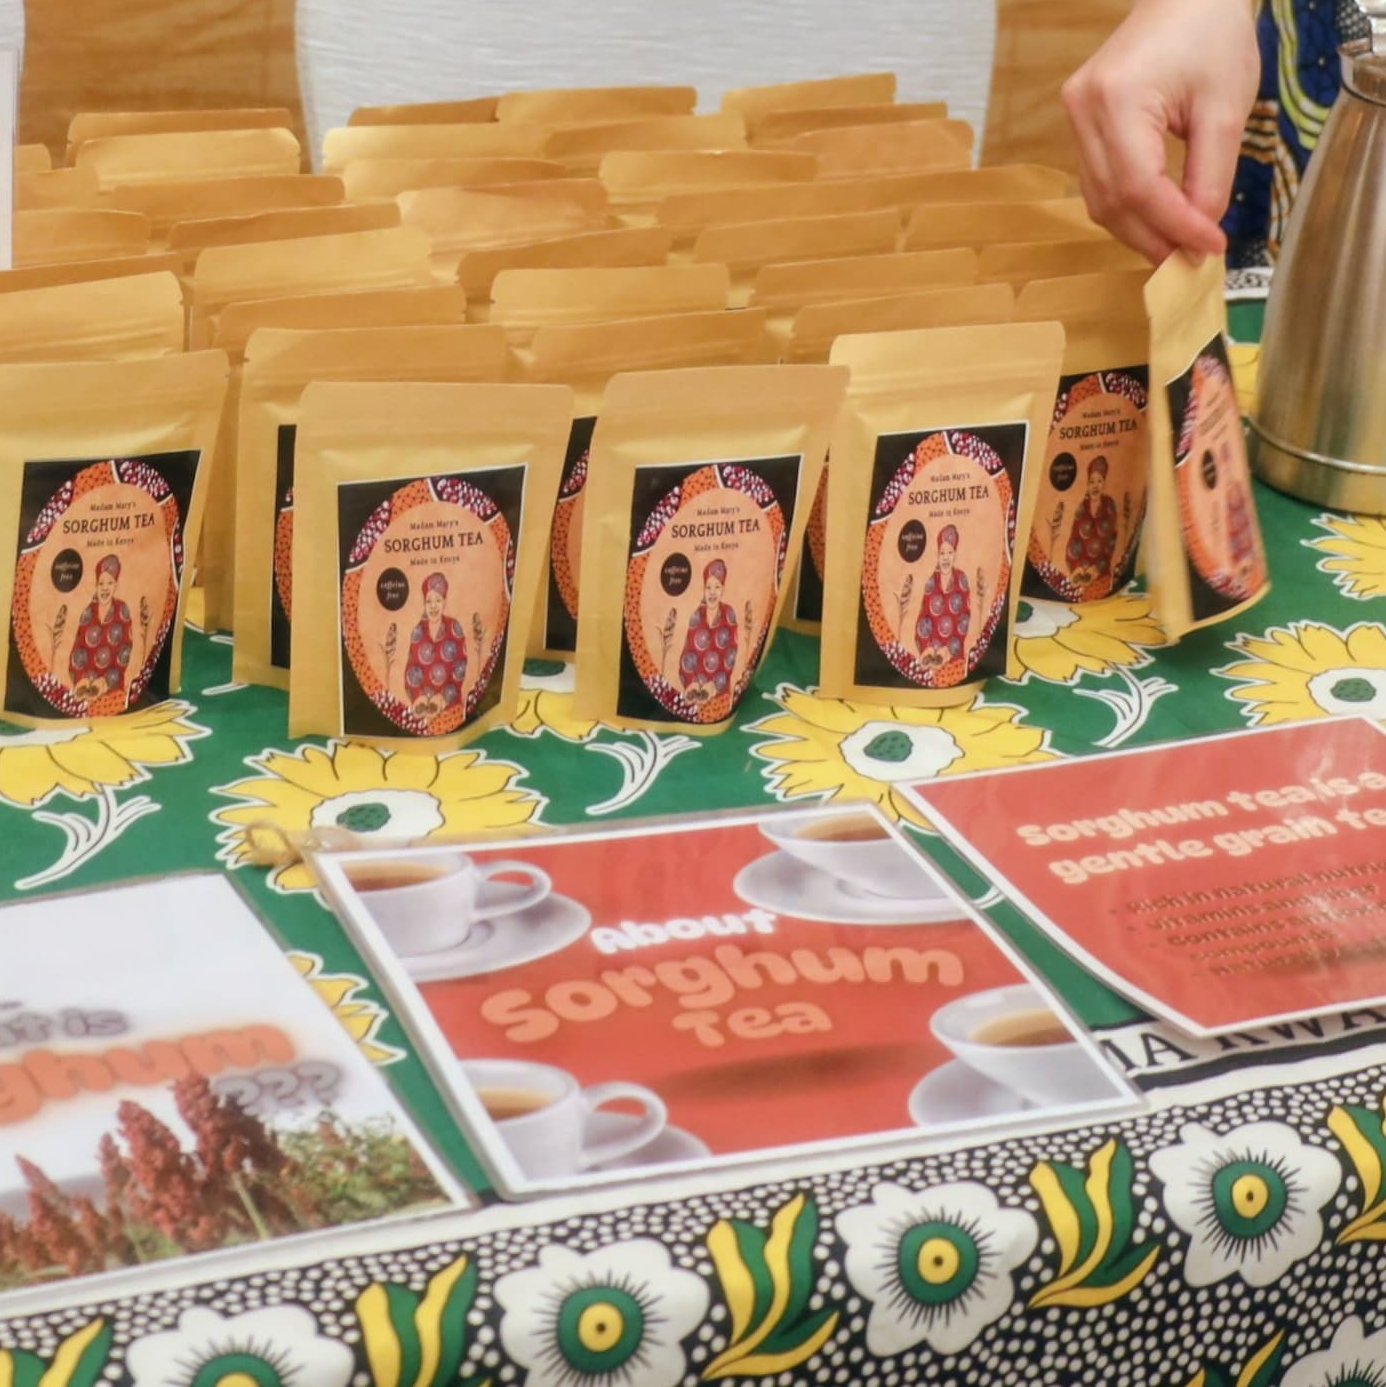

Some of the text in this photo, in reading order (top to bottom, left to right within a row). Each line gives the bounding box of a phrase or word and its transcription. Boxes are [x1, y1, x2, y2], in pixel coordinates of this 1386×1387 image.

[1059, 418, 1137, 439] SORGHUM TEA
[908, 485, 989, 505] SORGHUM TEA
[62, 513, 155, 534] SORGHUM TEA
[671, 518, 760, 539] SORGHUM TEA
[384, 531, 484, 553] SORGHUM TEA
[1015, 799, 1231, 847] Sorghum
[1225, 781, 1319, 813] tea
[1311, 776, 1359, 801] is
[1048, 836, 1215, 885] gentle
[1211, 812, 1339, 857] grain
[590, 906, 778, 955] About
[480, 943, 965, 1044] Sorghum
[59, 1007, 132, 1039] is
